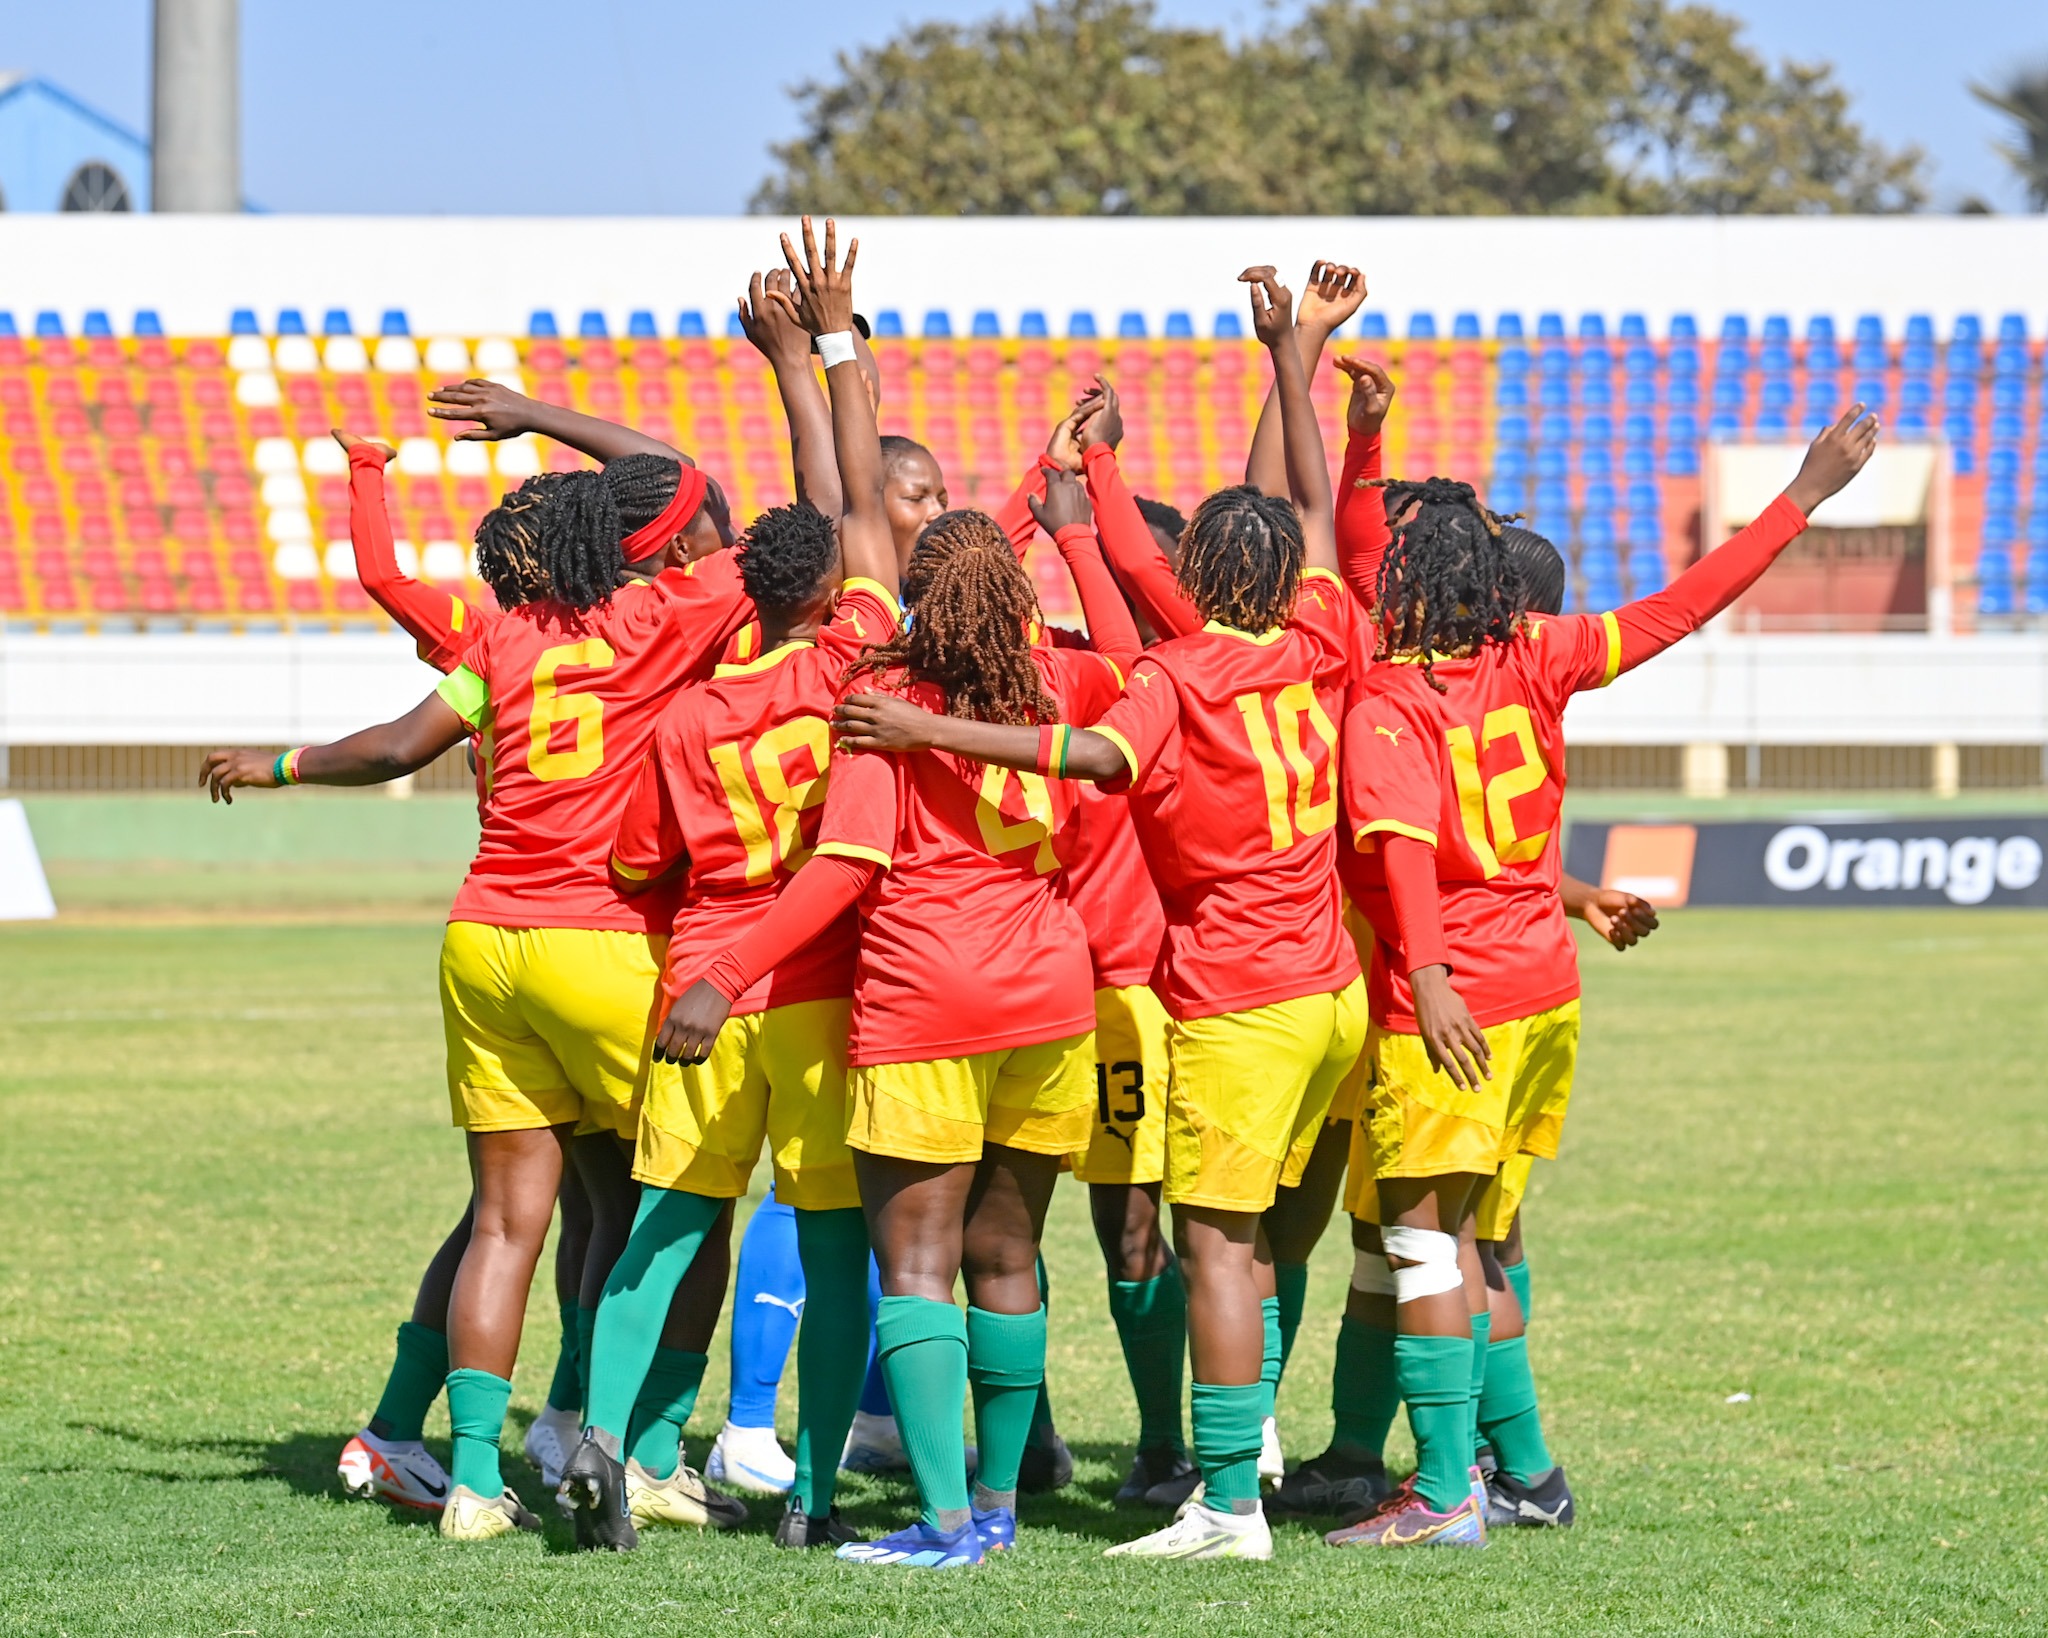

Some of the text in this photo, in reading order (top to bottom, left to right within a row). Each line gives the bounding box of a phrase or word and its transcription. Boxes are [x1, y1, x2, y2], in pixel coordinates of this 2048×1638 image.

[527, 637, 616, 782] 6
[1234, 681, 1338, 852] 10
[708, 715, 830, 887] 18
[1445, 703, 1550, 880] 12
[1764, 825, 2043, 905] Orange
[1095, 1061, 1146, 1124] 13
